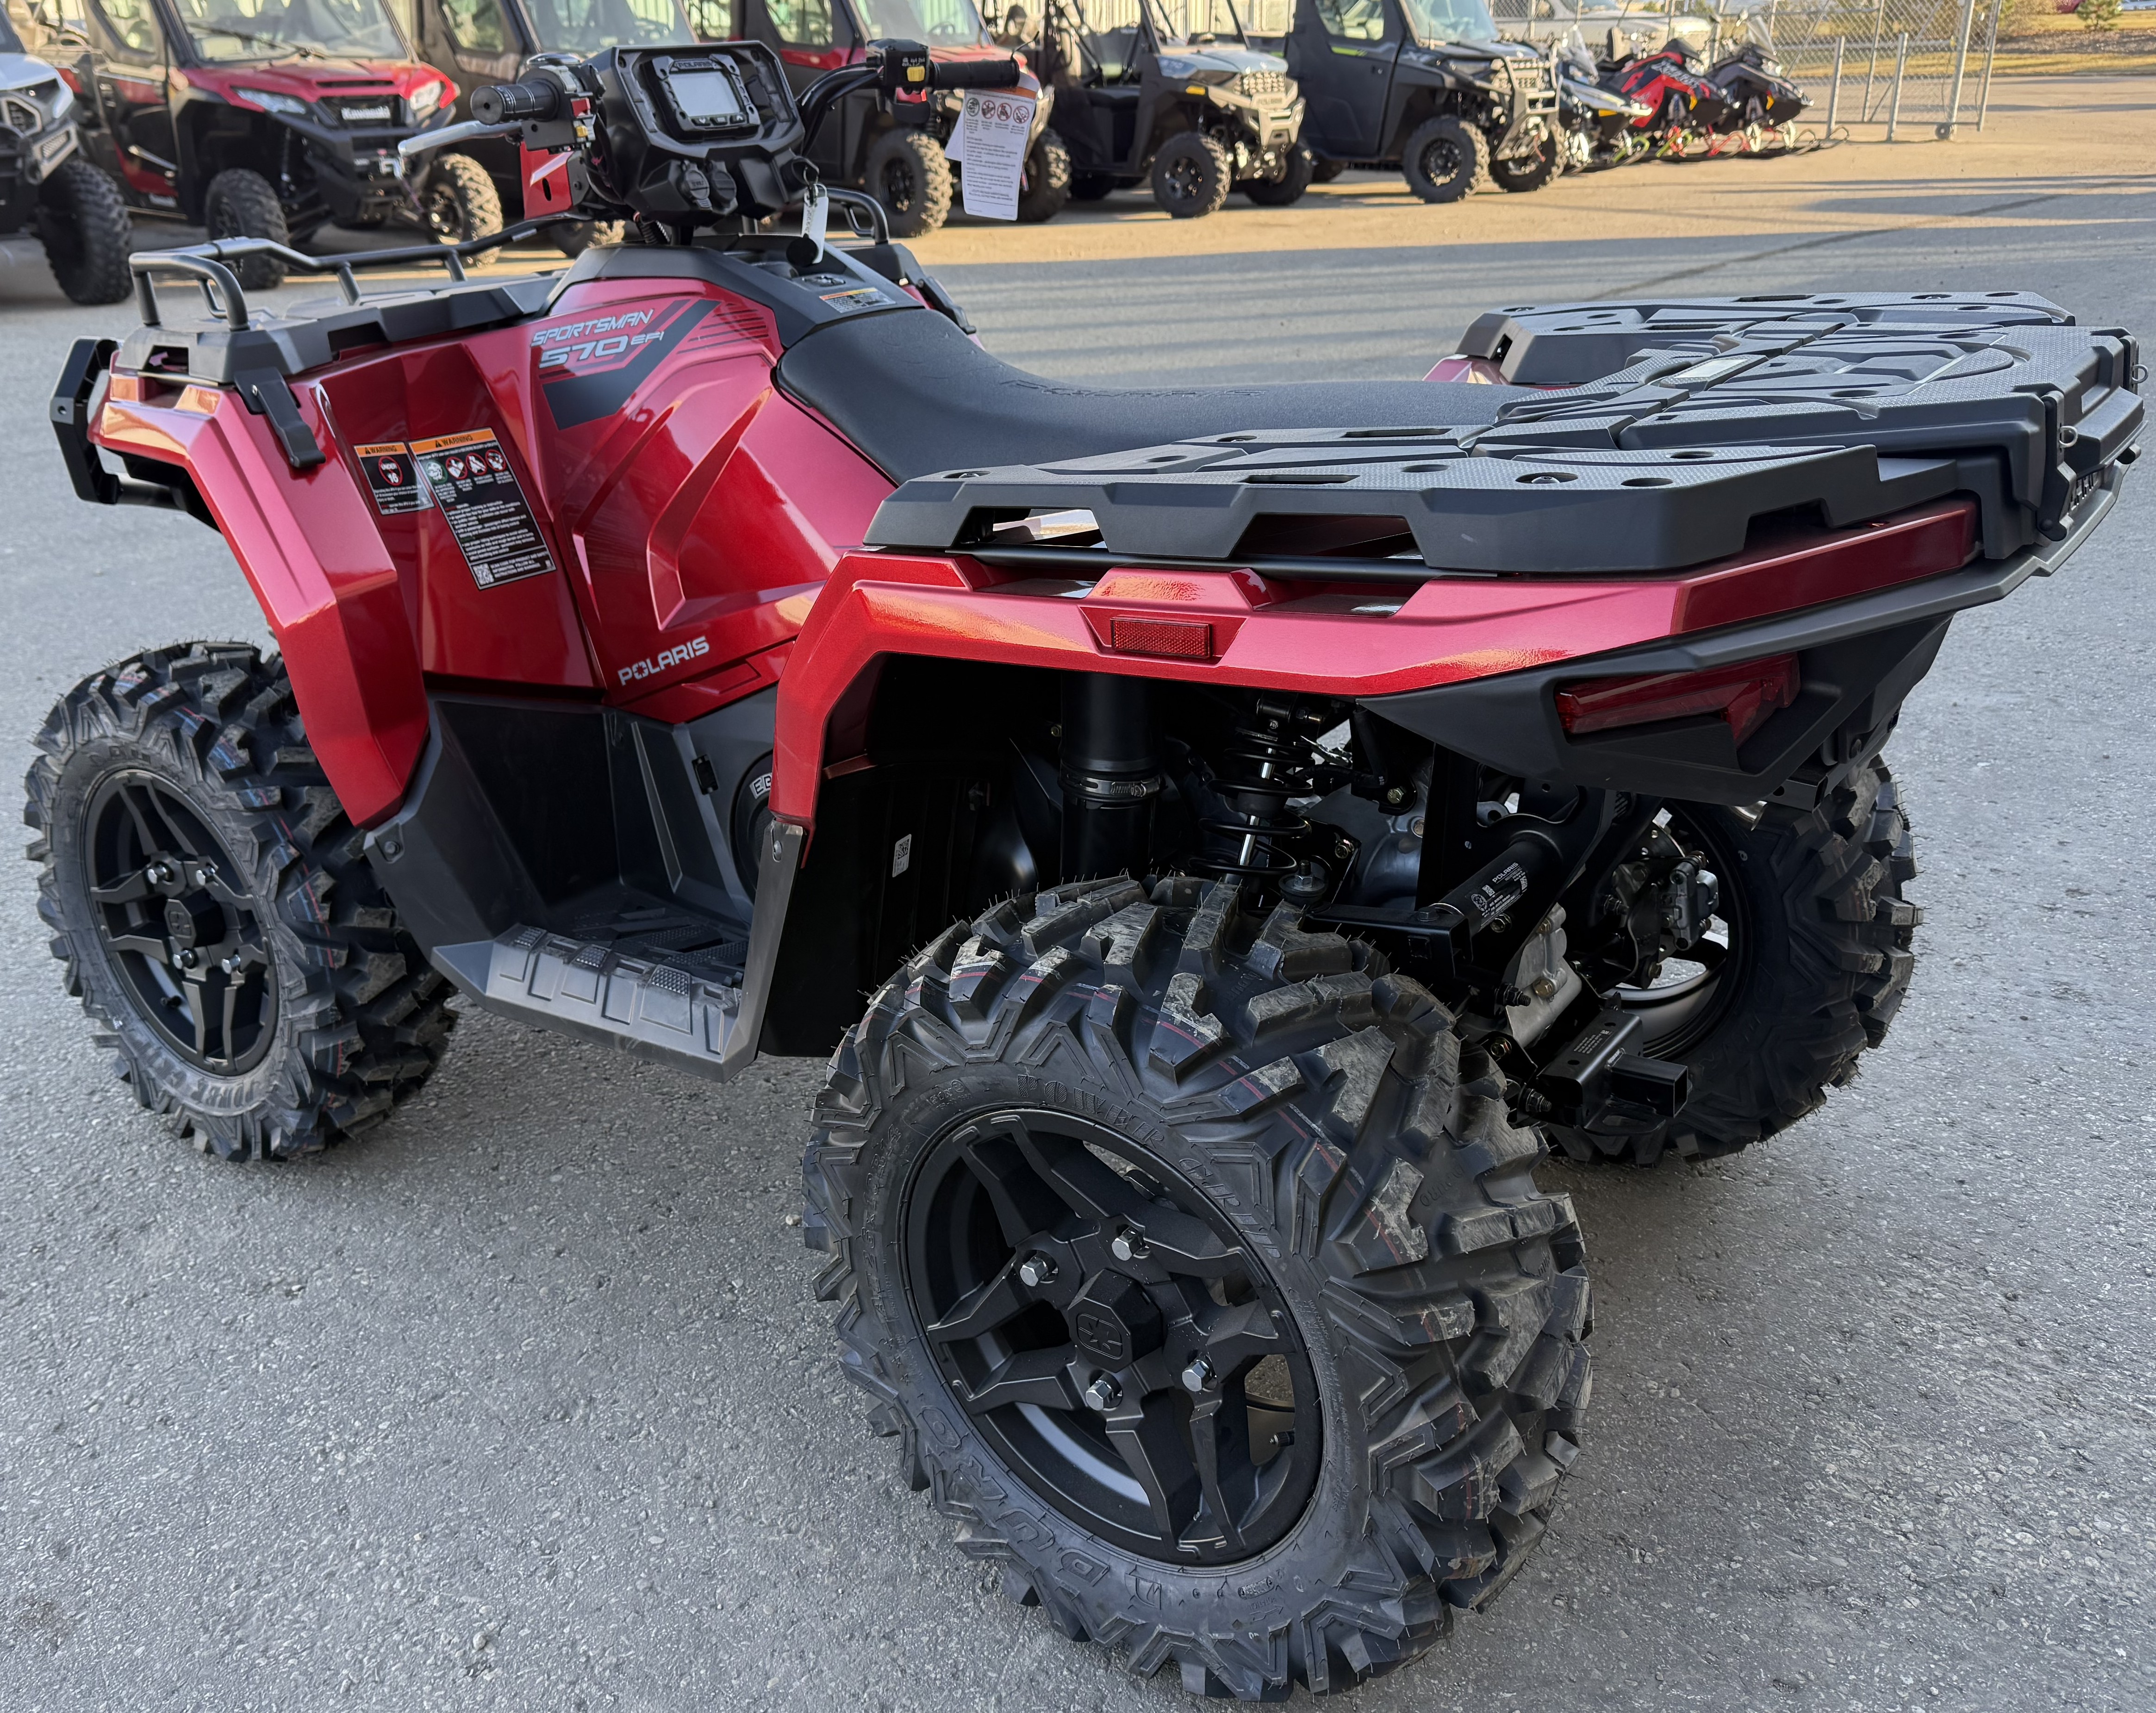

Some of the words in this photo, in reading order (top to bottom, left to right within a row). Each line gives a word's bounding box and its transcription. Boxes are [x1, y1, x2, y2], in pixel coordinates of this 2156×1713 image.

[530, 309, 654, 347] SPORTSMAN
[539, 335, 629, 368] 570
[630, 331, 665, 346] EFI
[442, 435, 473, 447] WARNING
[380, 462, 398, 471] UNDER
[388, 472, 399, 484] 16
[618, 635, 710, 686] POLARIS
[1492, 862, 1519, 883] POLARIS
[1018, 1074, 1164, 1148] POWER
[1179, 1159, 1282, 1258] GRIP
[916, 1405, 1111, 1588] DURO
